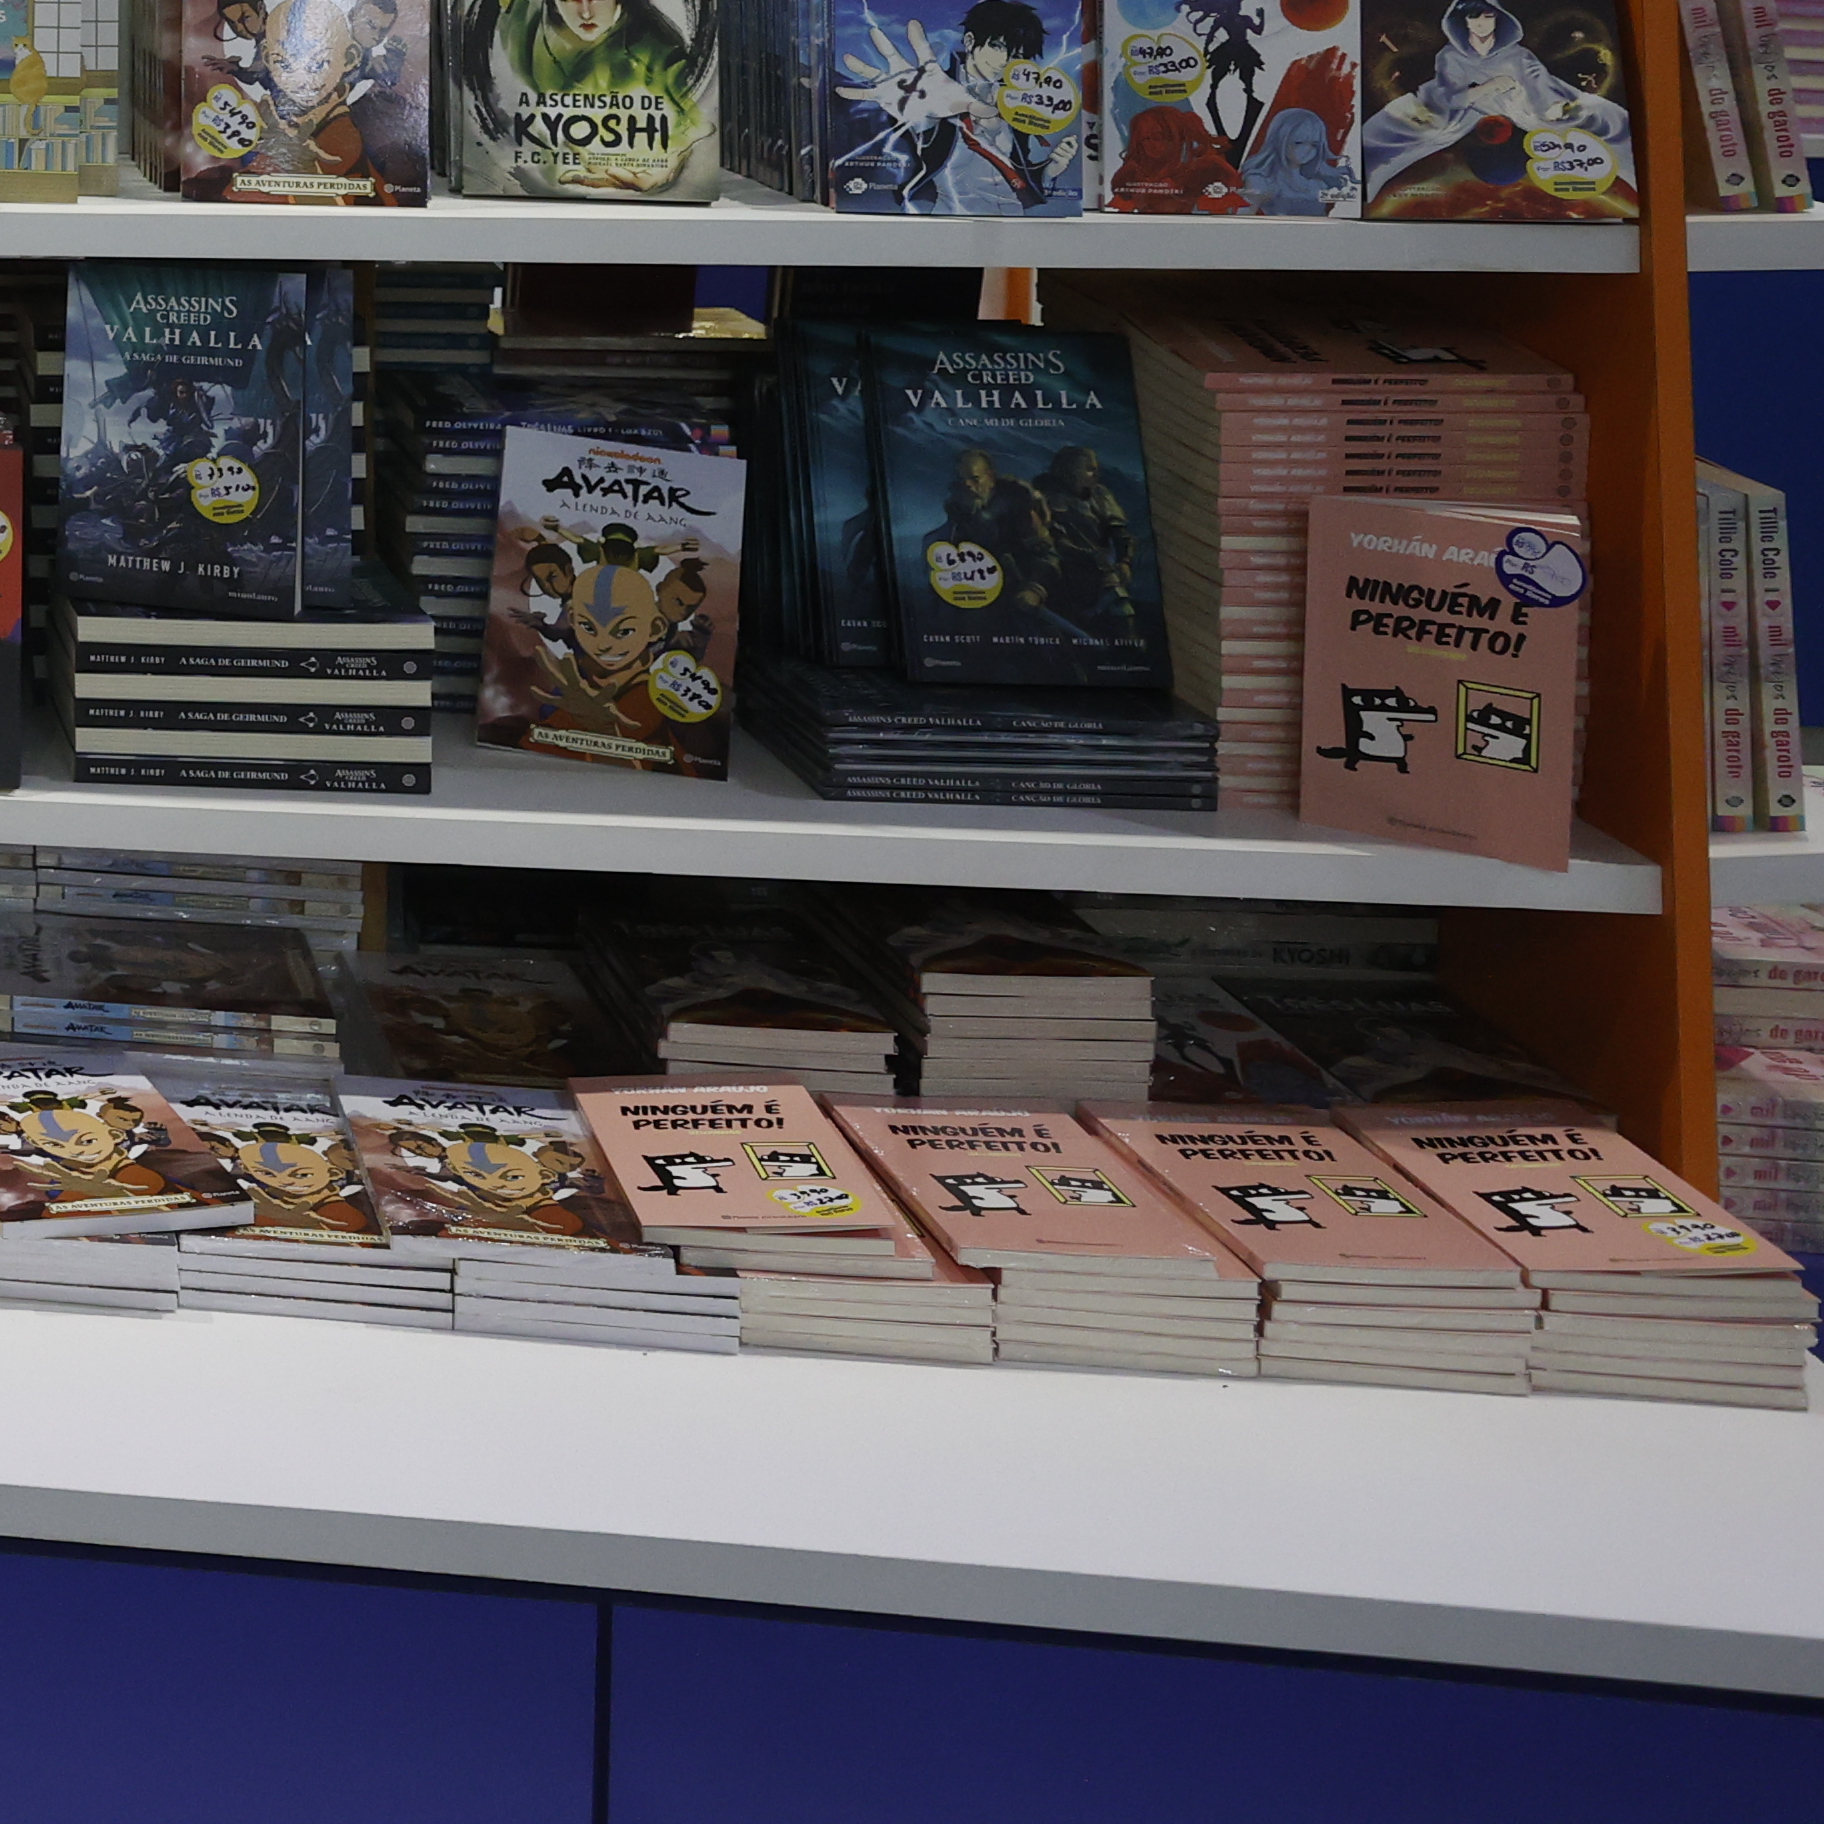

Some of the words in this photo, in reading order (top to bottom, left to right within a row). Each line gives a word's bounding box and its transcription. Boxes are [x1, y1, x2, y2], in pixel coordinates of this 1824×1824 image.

[518, 91, 530, 108] A
[535, 90, 635, 111] ASCENSÃO
[641, 95, 665, 111] DE
[513, 112, 670, 152] KYOSHI
[552, 150, 582, 166] YEE
[238, 178, 252, 189] AS
[255, 179, 313, 191] AVENTURAS
[315, 180, 368, 193] PERDIDAS
[156, 310, 212, 326] CREED
[103, 323, 264, 351] VALHALLA
[966, 369, 1035, 385] CREED
[904, 388, 1104, 410] VALHALLA
[540, 466, 718, 517] AVATAR
[1349, 531, 1438, 560] YORHÁN
[107, 553, 172, 574] MATTHEW
[197, 561, 241, 580] KIRBY
[1344, 575, 1502, 622] NINGUÉM
[1349, 608, 1528, 659] PERFEITO!
[1770, 728, 1792, 779] garoto
[620, 1099, 755, 1118] NINGUÉM
[764, 1098, 782, 1117] É
[632, 1117, 785, 1132] PERFEITO!
[1412, 1129, 1559, 1150] NINGUÉM
[1437, 1147, 1604, 1164] PERFEITO!
[70, 1197, 141, 1211] AVENTURAS
[143, 1193, 191, 1207] PERDIDAS
